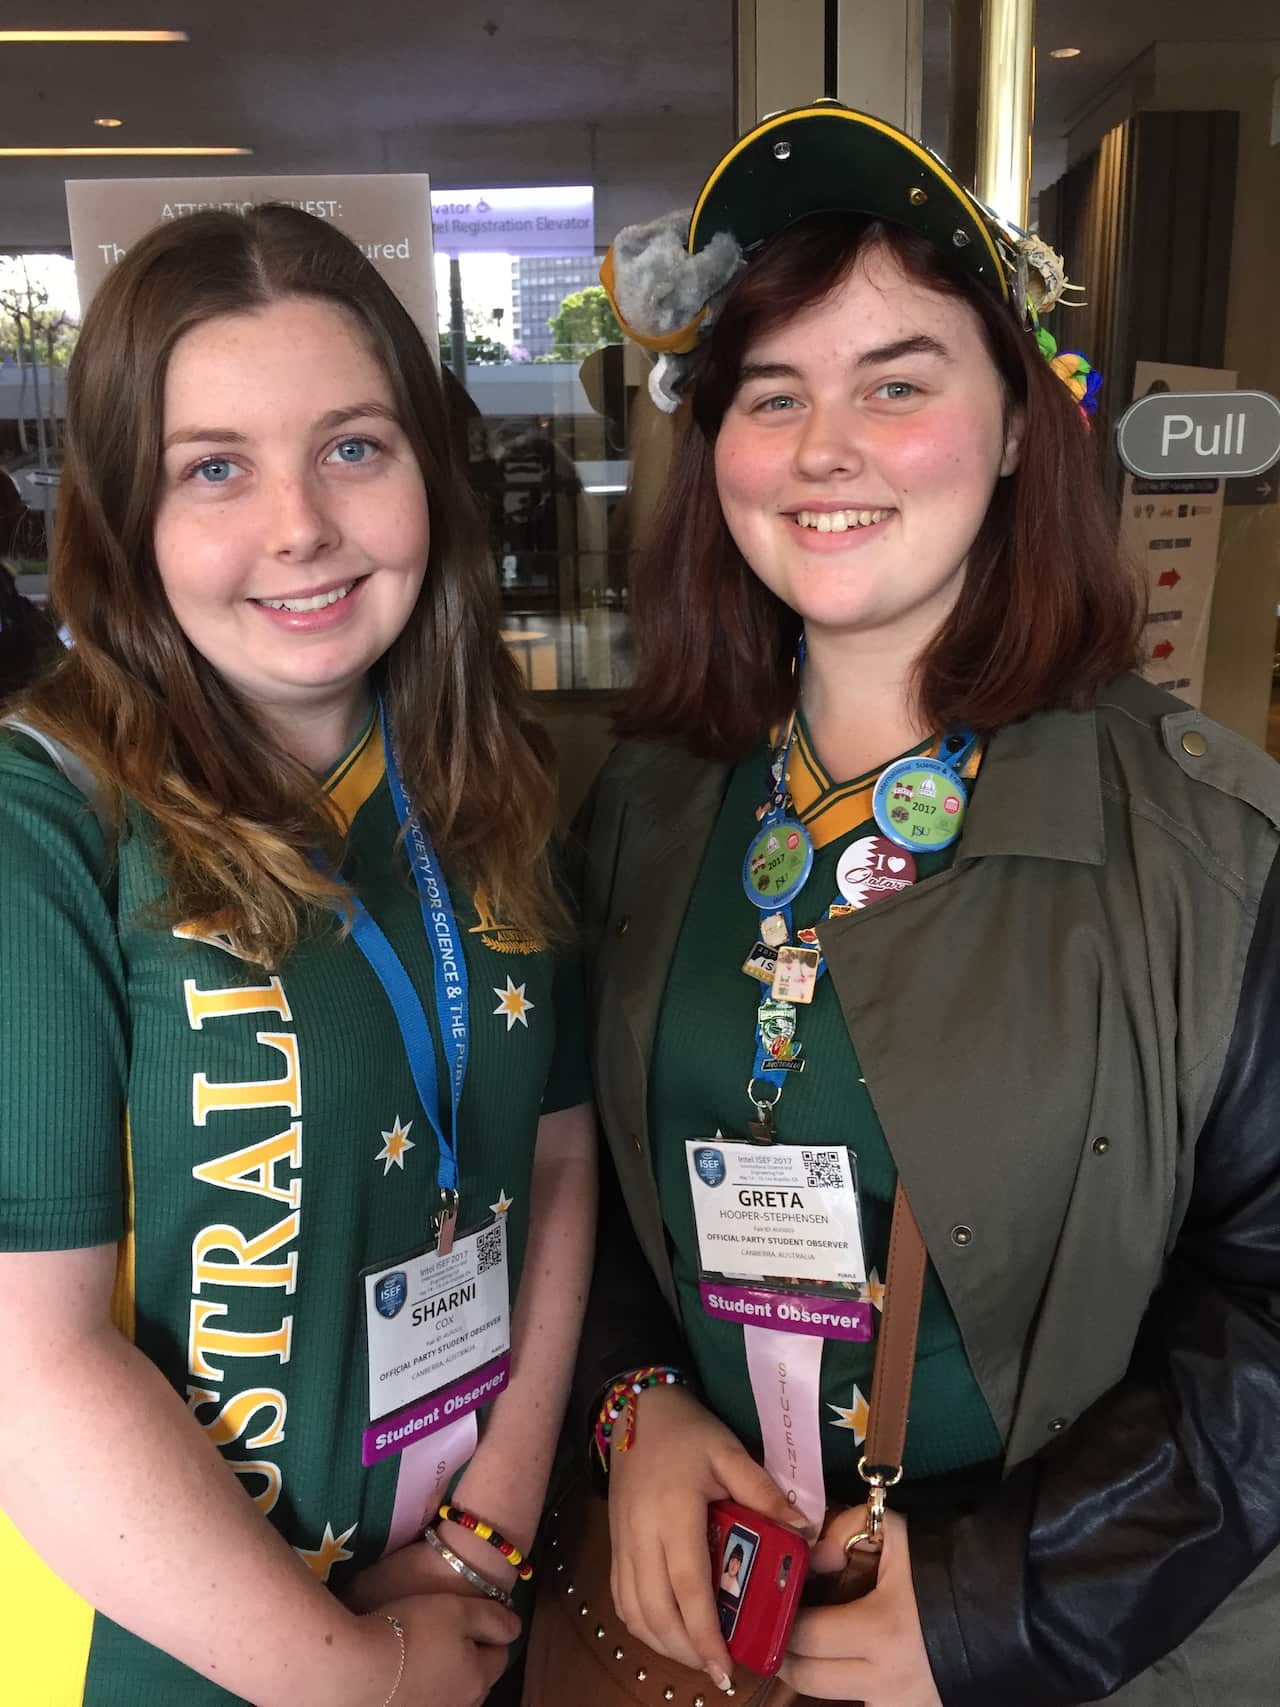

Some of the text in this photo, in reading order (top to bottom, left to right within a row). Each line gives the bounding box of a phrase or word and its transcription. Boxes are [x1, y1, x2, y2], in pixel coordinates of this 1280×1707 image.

[452, 218, 533, 237] Registration
[536, 216, 590, 231] Elevator
[1161, 413, 1246, 456] Pull
[912, 801, 937, 815] 2017
[876, 854, 886, 870] I
[845, 867, 912, 891] Qatar
[423, 875, 442, 909] FOR
[432, 911, 460, 984] SCIENCE
[447, 986, 462, 1000] &
[450, 1001, 467, 1039] THE
[699, 1159, 720, 1169] ISEF
[737, 1155, 792, 1165] Intel ISEF 2017
[738, 1190, 804, 1208] GRETA
[719, 1209, 829, 1224] HOOPER-STEPHENSEN
[706, 1232, 849, 1249] OFFICIAL PARTY STUDENT OBSERVER
[451, 1250, 469, 1263] 2017
[778, 1251, 816, 1261] AUSTRALIA
[380, 1284, 401, 1301] ISEF
[411, 1282, 476, 1328] SHARNI
[706, 1293, 860, 1329] Student Observer
[435, 1315, 455, 1331] COX
[379, 1361, 411, 1381] OFFICIAL
[412, 1350, 437, 1366] PARTY
[437, 1332, 469, 1354] STUDENT
[470, 1315, 502, 1337] OBSERVER
[374, 1369, 506, 1451] Student Observer
[777, 1362, 797, 1481] STUDENT
